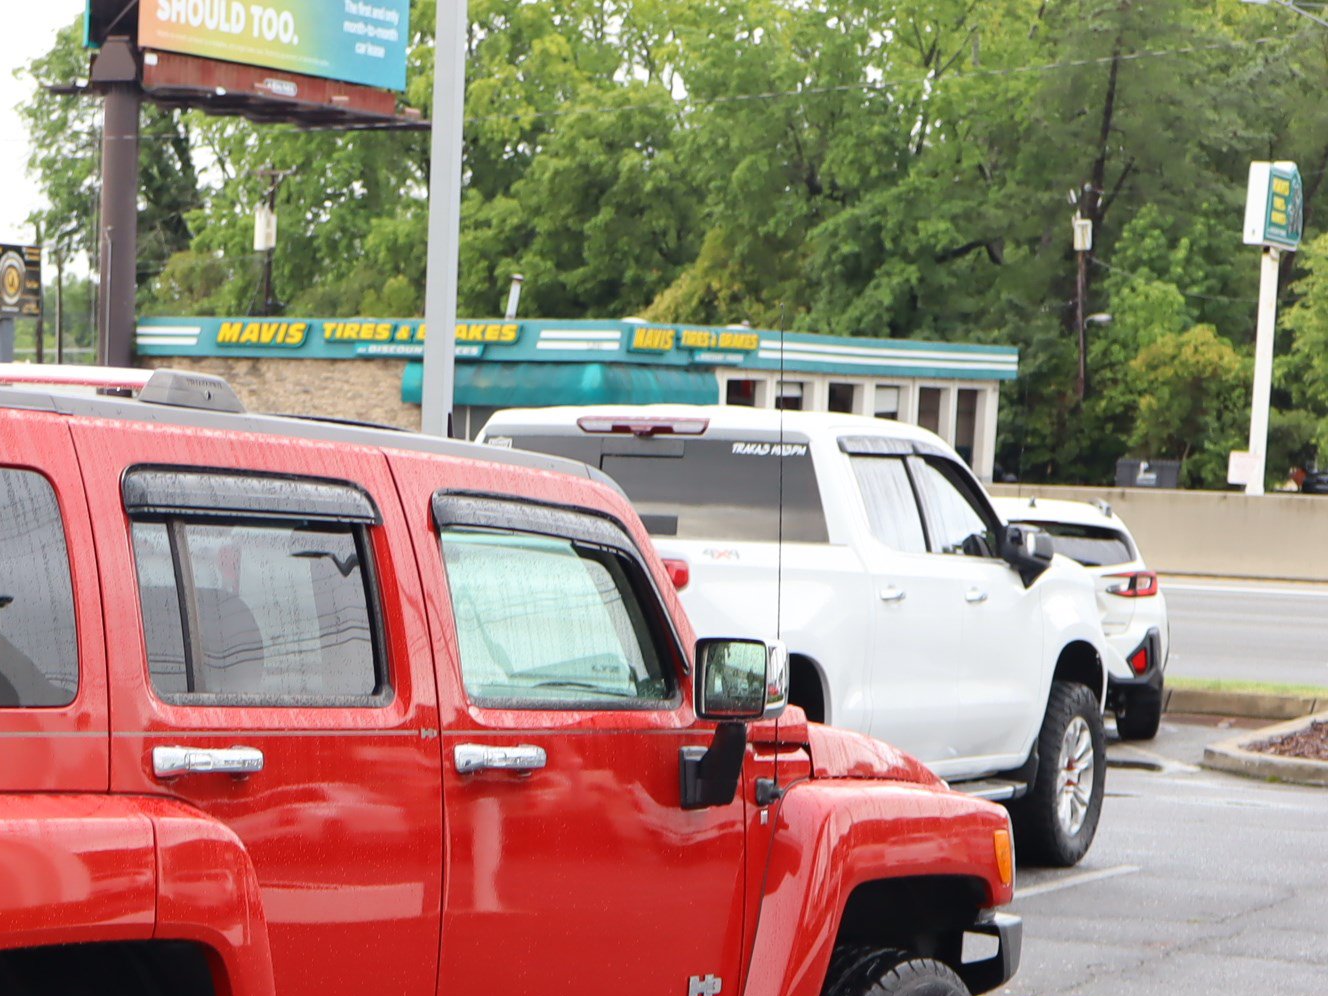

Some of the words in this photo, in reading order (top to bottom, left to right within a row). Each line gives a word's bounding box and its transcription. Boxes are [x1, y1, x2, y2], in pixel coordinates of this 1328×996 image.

[156, 0, 246, 34] SHOULD
[250, 5, 299, 45] TOO.
[217, 322, 307, 345] MAVIS
[323, 322, 393, 341] TIRES
[396, 324, 411, 341] &
[416, 323, 519, 343] BAKES
[633, 327, 675, 350] MAVIS
[367, 343, 425, 355] DISCOUN
